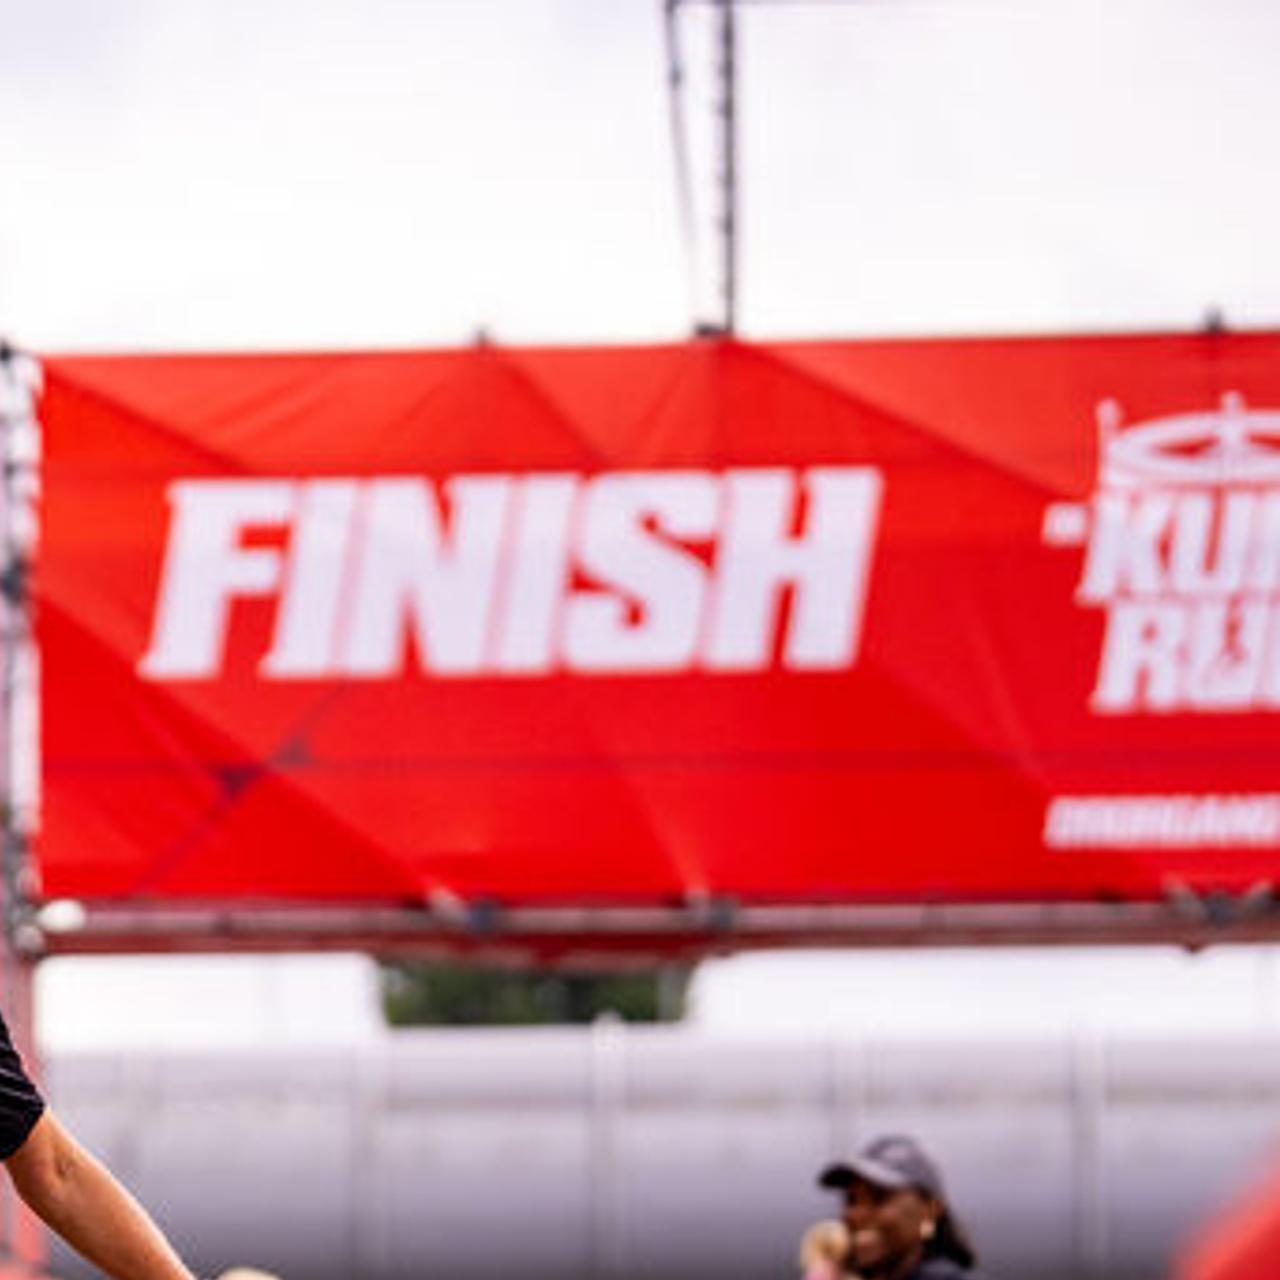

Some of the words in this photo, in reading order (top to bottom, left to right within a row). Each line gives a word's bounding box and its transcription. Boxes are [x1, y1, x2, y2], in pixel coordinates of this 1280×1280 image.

[139, 467, 883, 677] FINISH
[1075, 490, 1280, 604] KUI
[1090, 600, 1280, 713] RU
